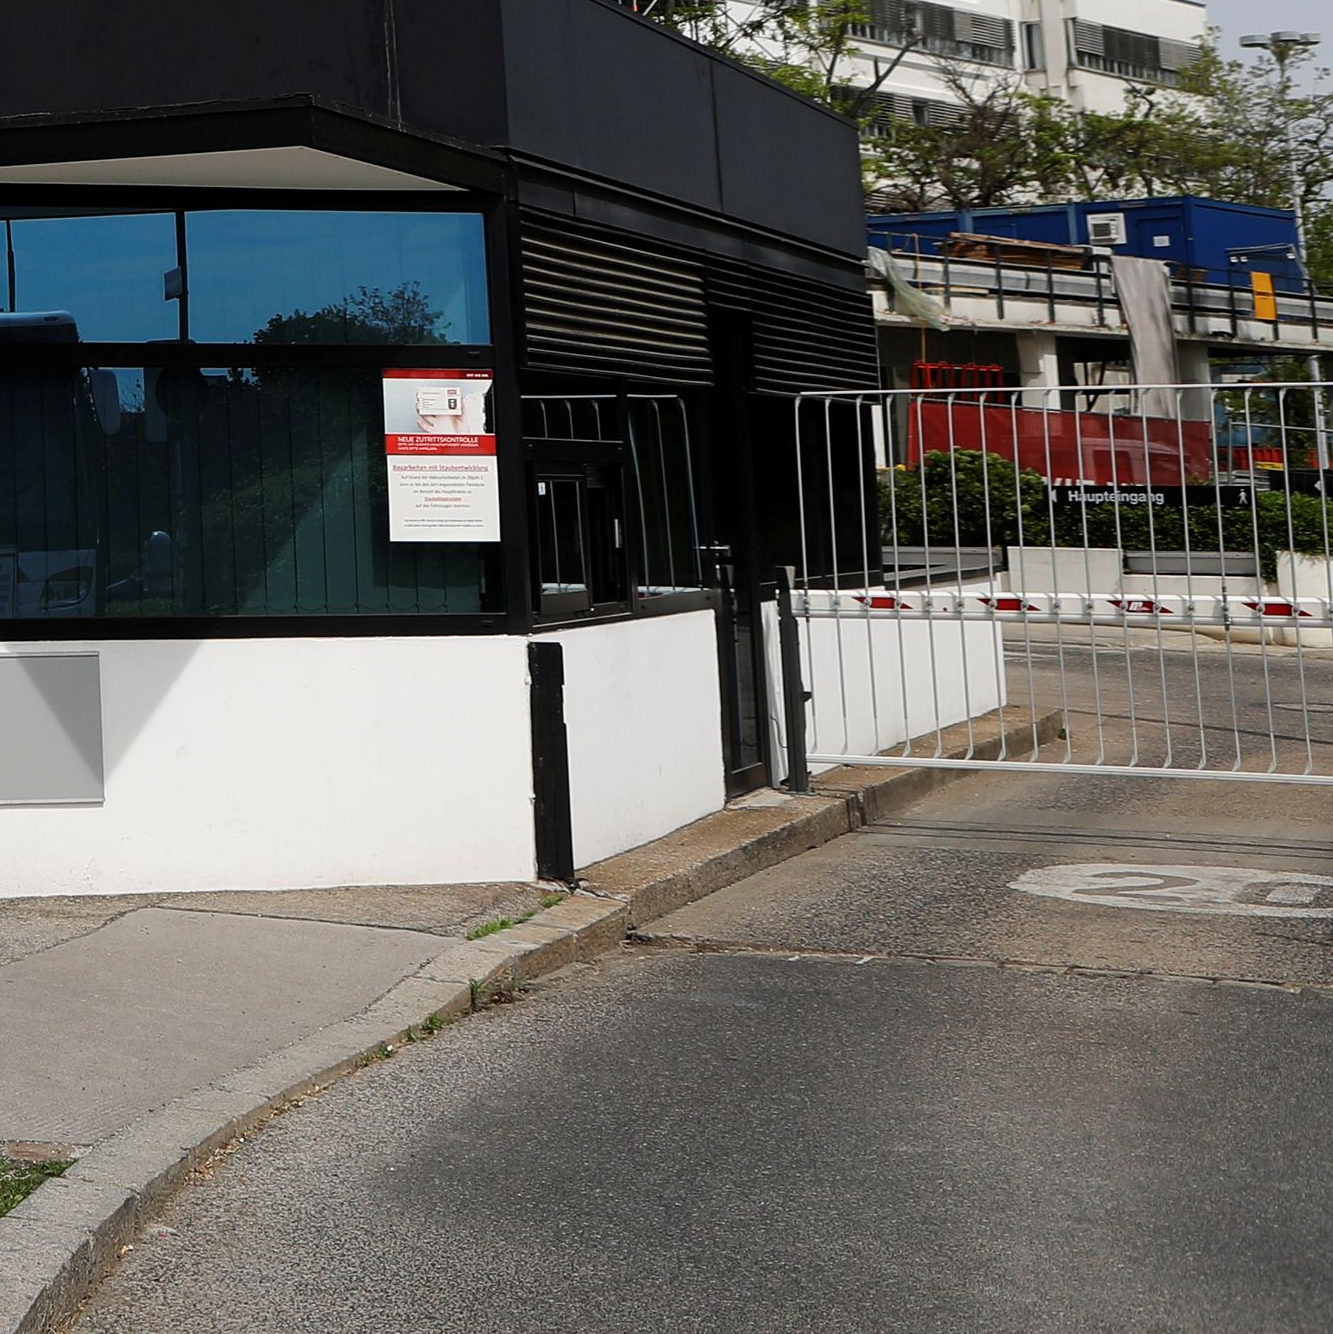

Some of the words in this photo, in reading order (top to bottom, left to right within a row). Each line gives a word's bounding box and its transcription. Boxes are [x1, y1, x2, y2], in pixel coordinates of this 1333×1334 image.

[393, 464, 428, 472] Bauarbeiten
[428, 464, 438, 472] mit
[439, 464, 488, 472] Staubentwicklung
[1067, 490, 1164, 504] Haupteingang
